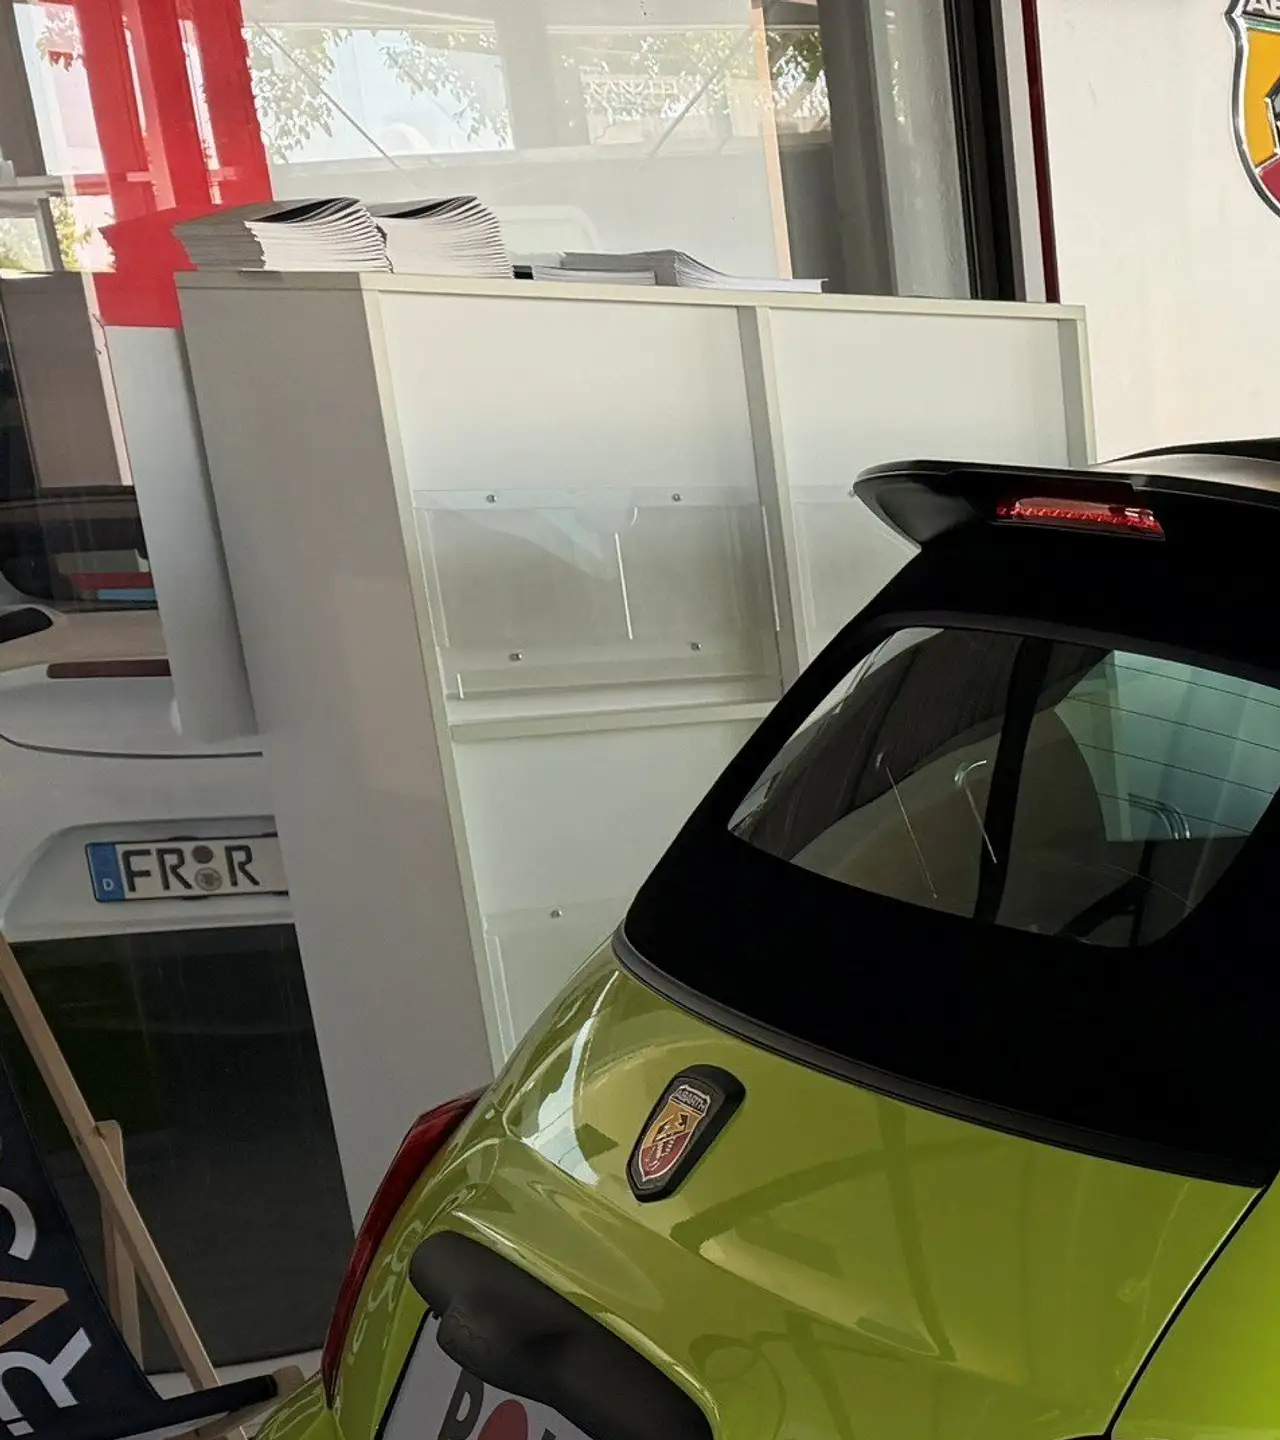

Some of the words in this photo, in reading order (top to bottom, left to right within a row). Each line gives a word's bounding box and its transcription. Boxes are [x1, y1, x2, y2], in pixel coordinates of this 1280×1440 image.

[122, 847, 193, 893] FR
[224, 845, 260, 887] R
[675, 1090, 706, 1111] ABARTH
